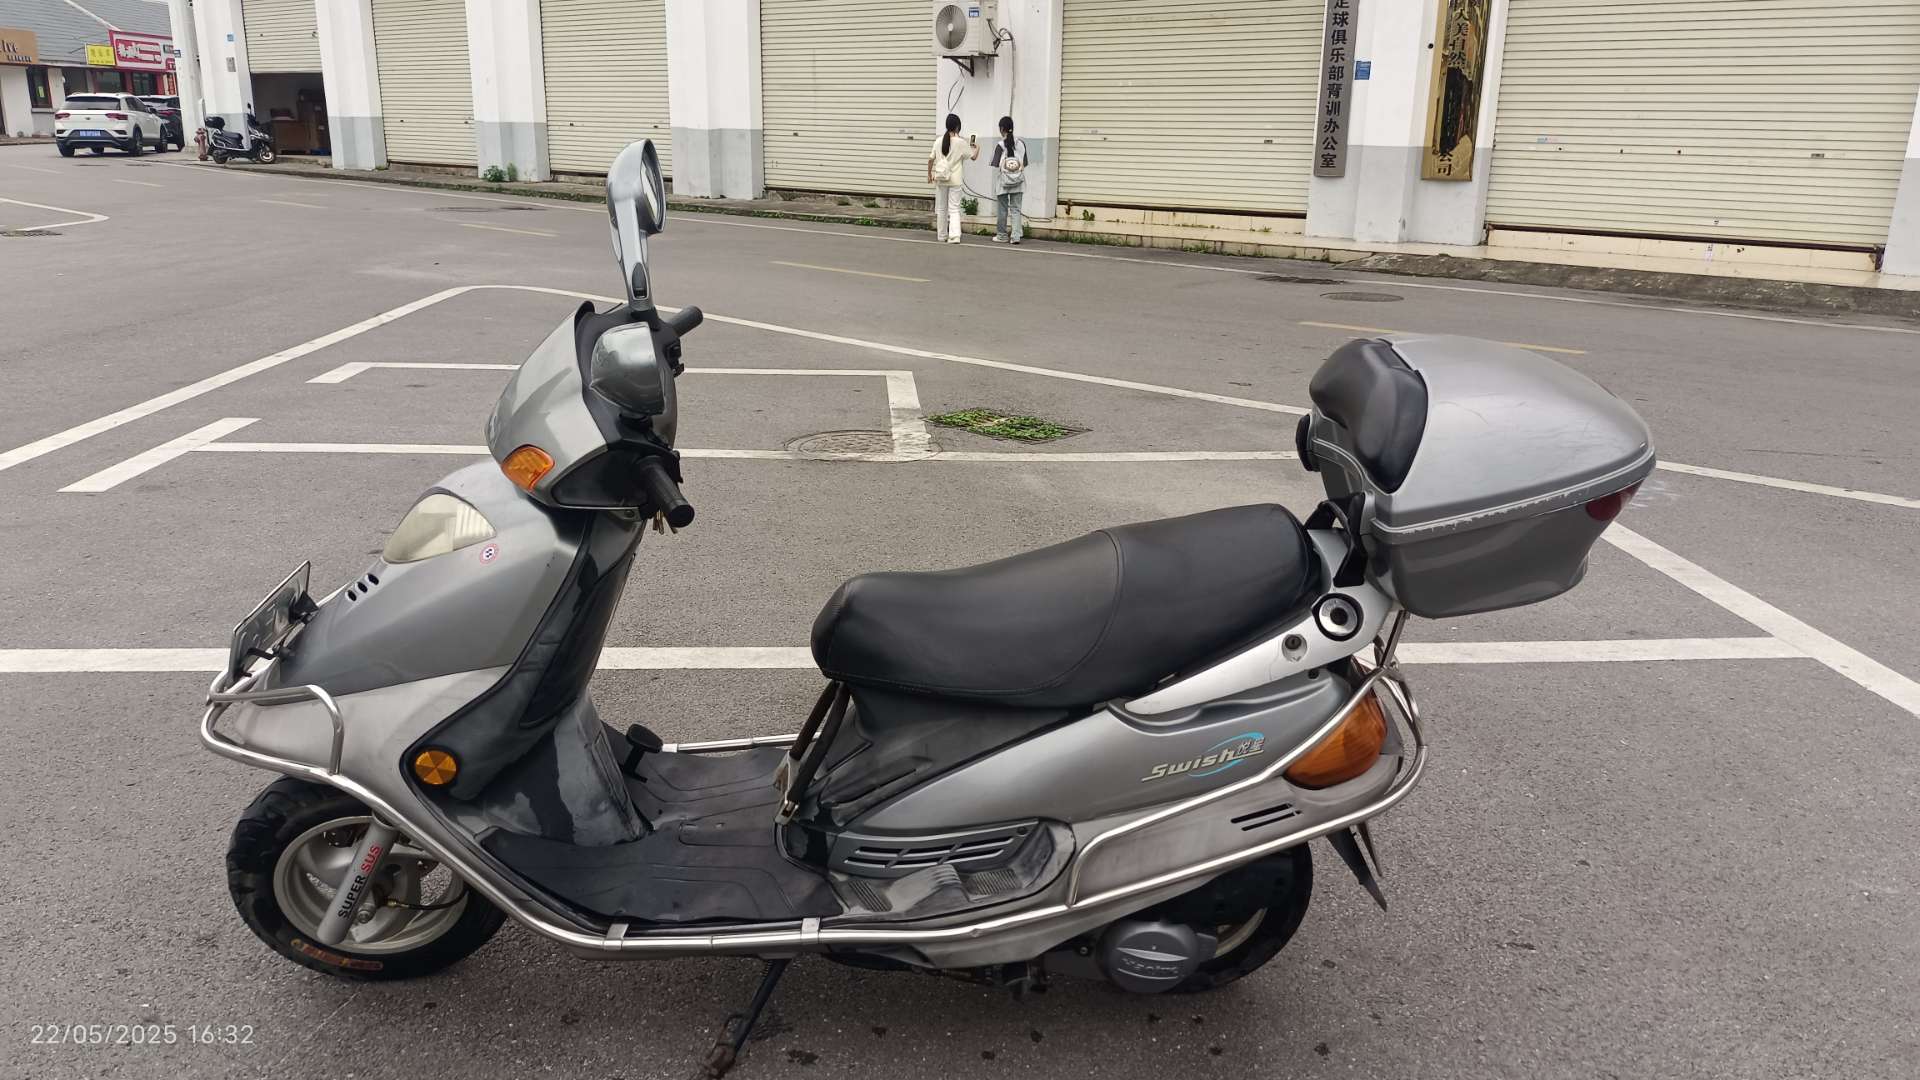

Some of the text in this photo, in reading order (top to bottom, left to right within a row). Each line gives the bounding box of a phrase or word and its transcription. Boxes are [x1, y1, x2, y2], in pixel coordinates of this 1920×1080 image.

[1141, 748, 1236, 782] Swish
[337, 844, 383, 919] SUPER SUS
